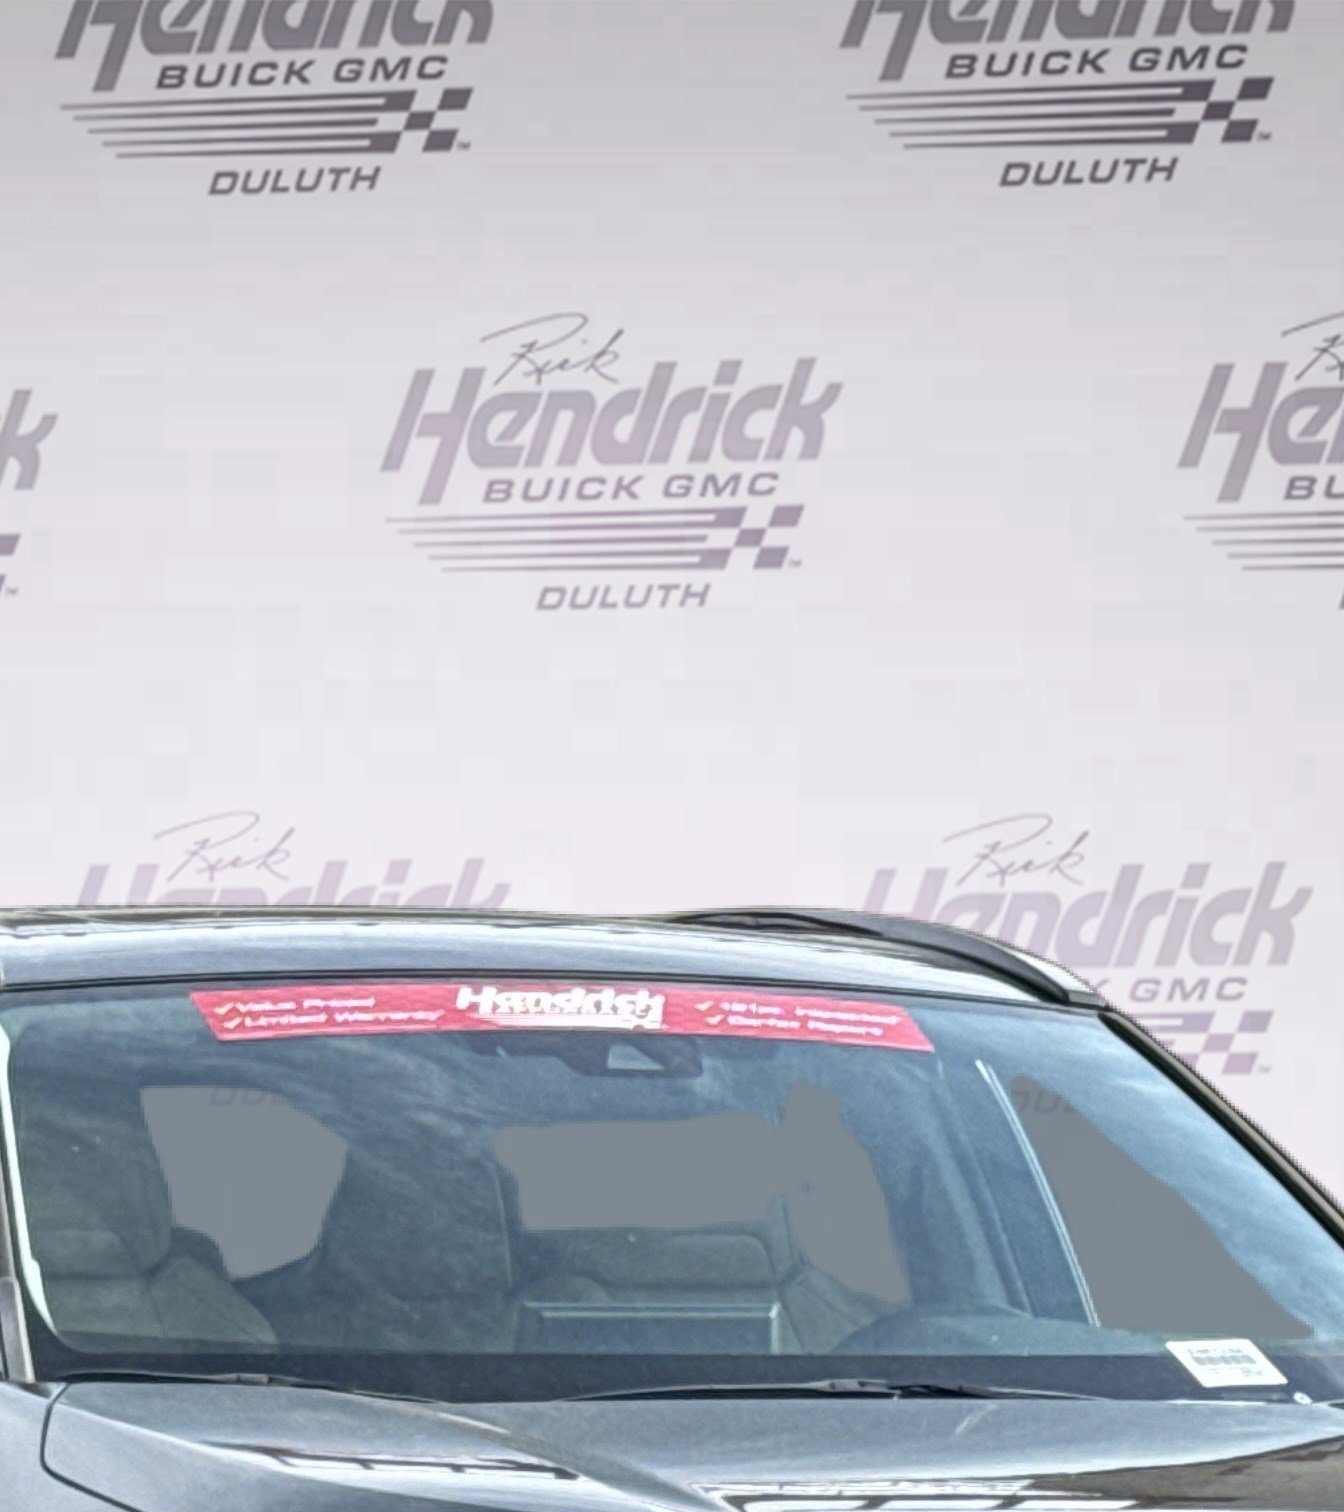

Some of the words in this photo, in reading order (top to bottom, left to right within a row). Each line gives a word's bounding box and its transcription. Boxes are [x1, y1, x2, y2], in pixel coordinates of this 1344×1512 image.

[155, 59, 316, 89] BUICK
[333, 56, 449, 84] GMC
[945, 49, 1111, 79] BUICK
[1128, 44, 1250, 72] GMC
[208, 167, 382, 196] DULUTH
[999, 157, 1179, 188] DULUTH
[379, 357, 844, 506] Hendrick
[482, 475, 645, 504] BUICK
[662, 472, 780, 498] GMC
[535, 583, 711, 611] DULUTH
[1129, 977, 1248, 1001] GMC
